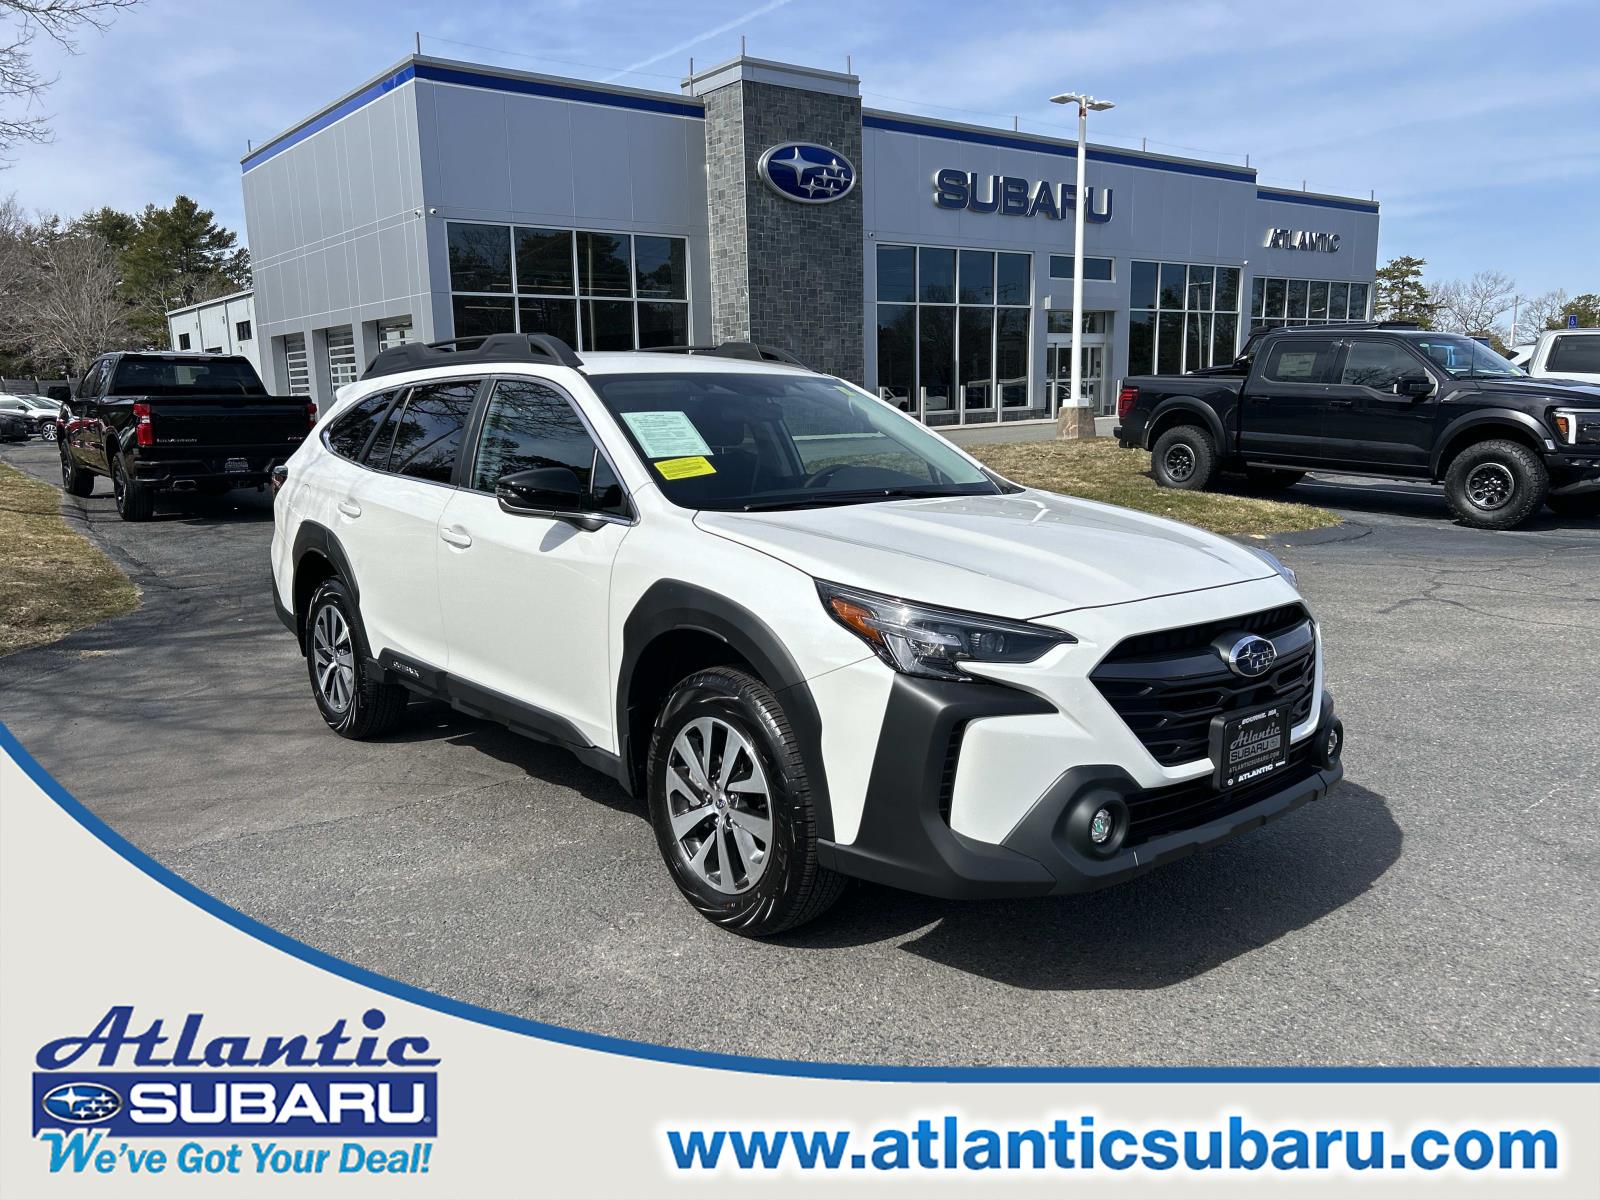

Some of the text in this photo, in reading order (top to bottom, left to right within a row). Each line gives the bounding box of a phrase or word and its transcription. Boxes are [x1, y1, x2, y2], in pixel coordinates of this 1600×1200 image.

[934, 168, 1113, 223] SUBARU
[1264, 228, 1341, 253] ATLANTIC
[1230, 722, 1281, 750] Atlantic
[1231, 740, 1269, 762] SUBARU
[1238, 763, 1274, 782] ATLANTIC
